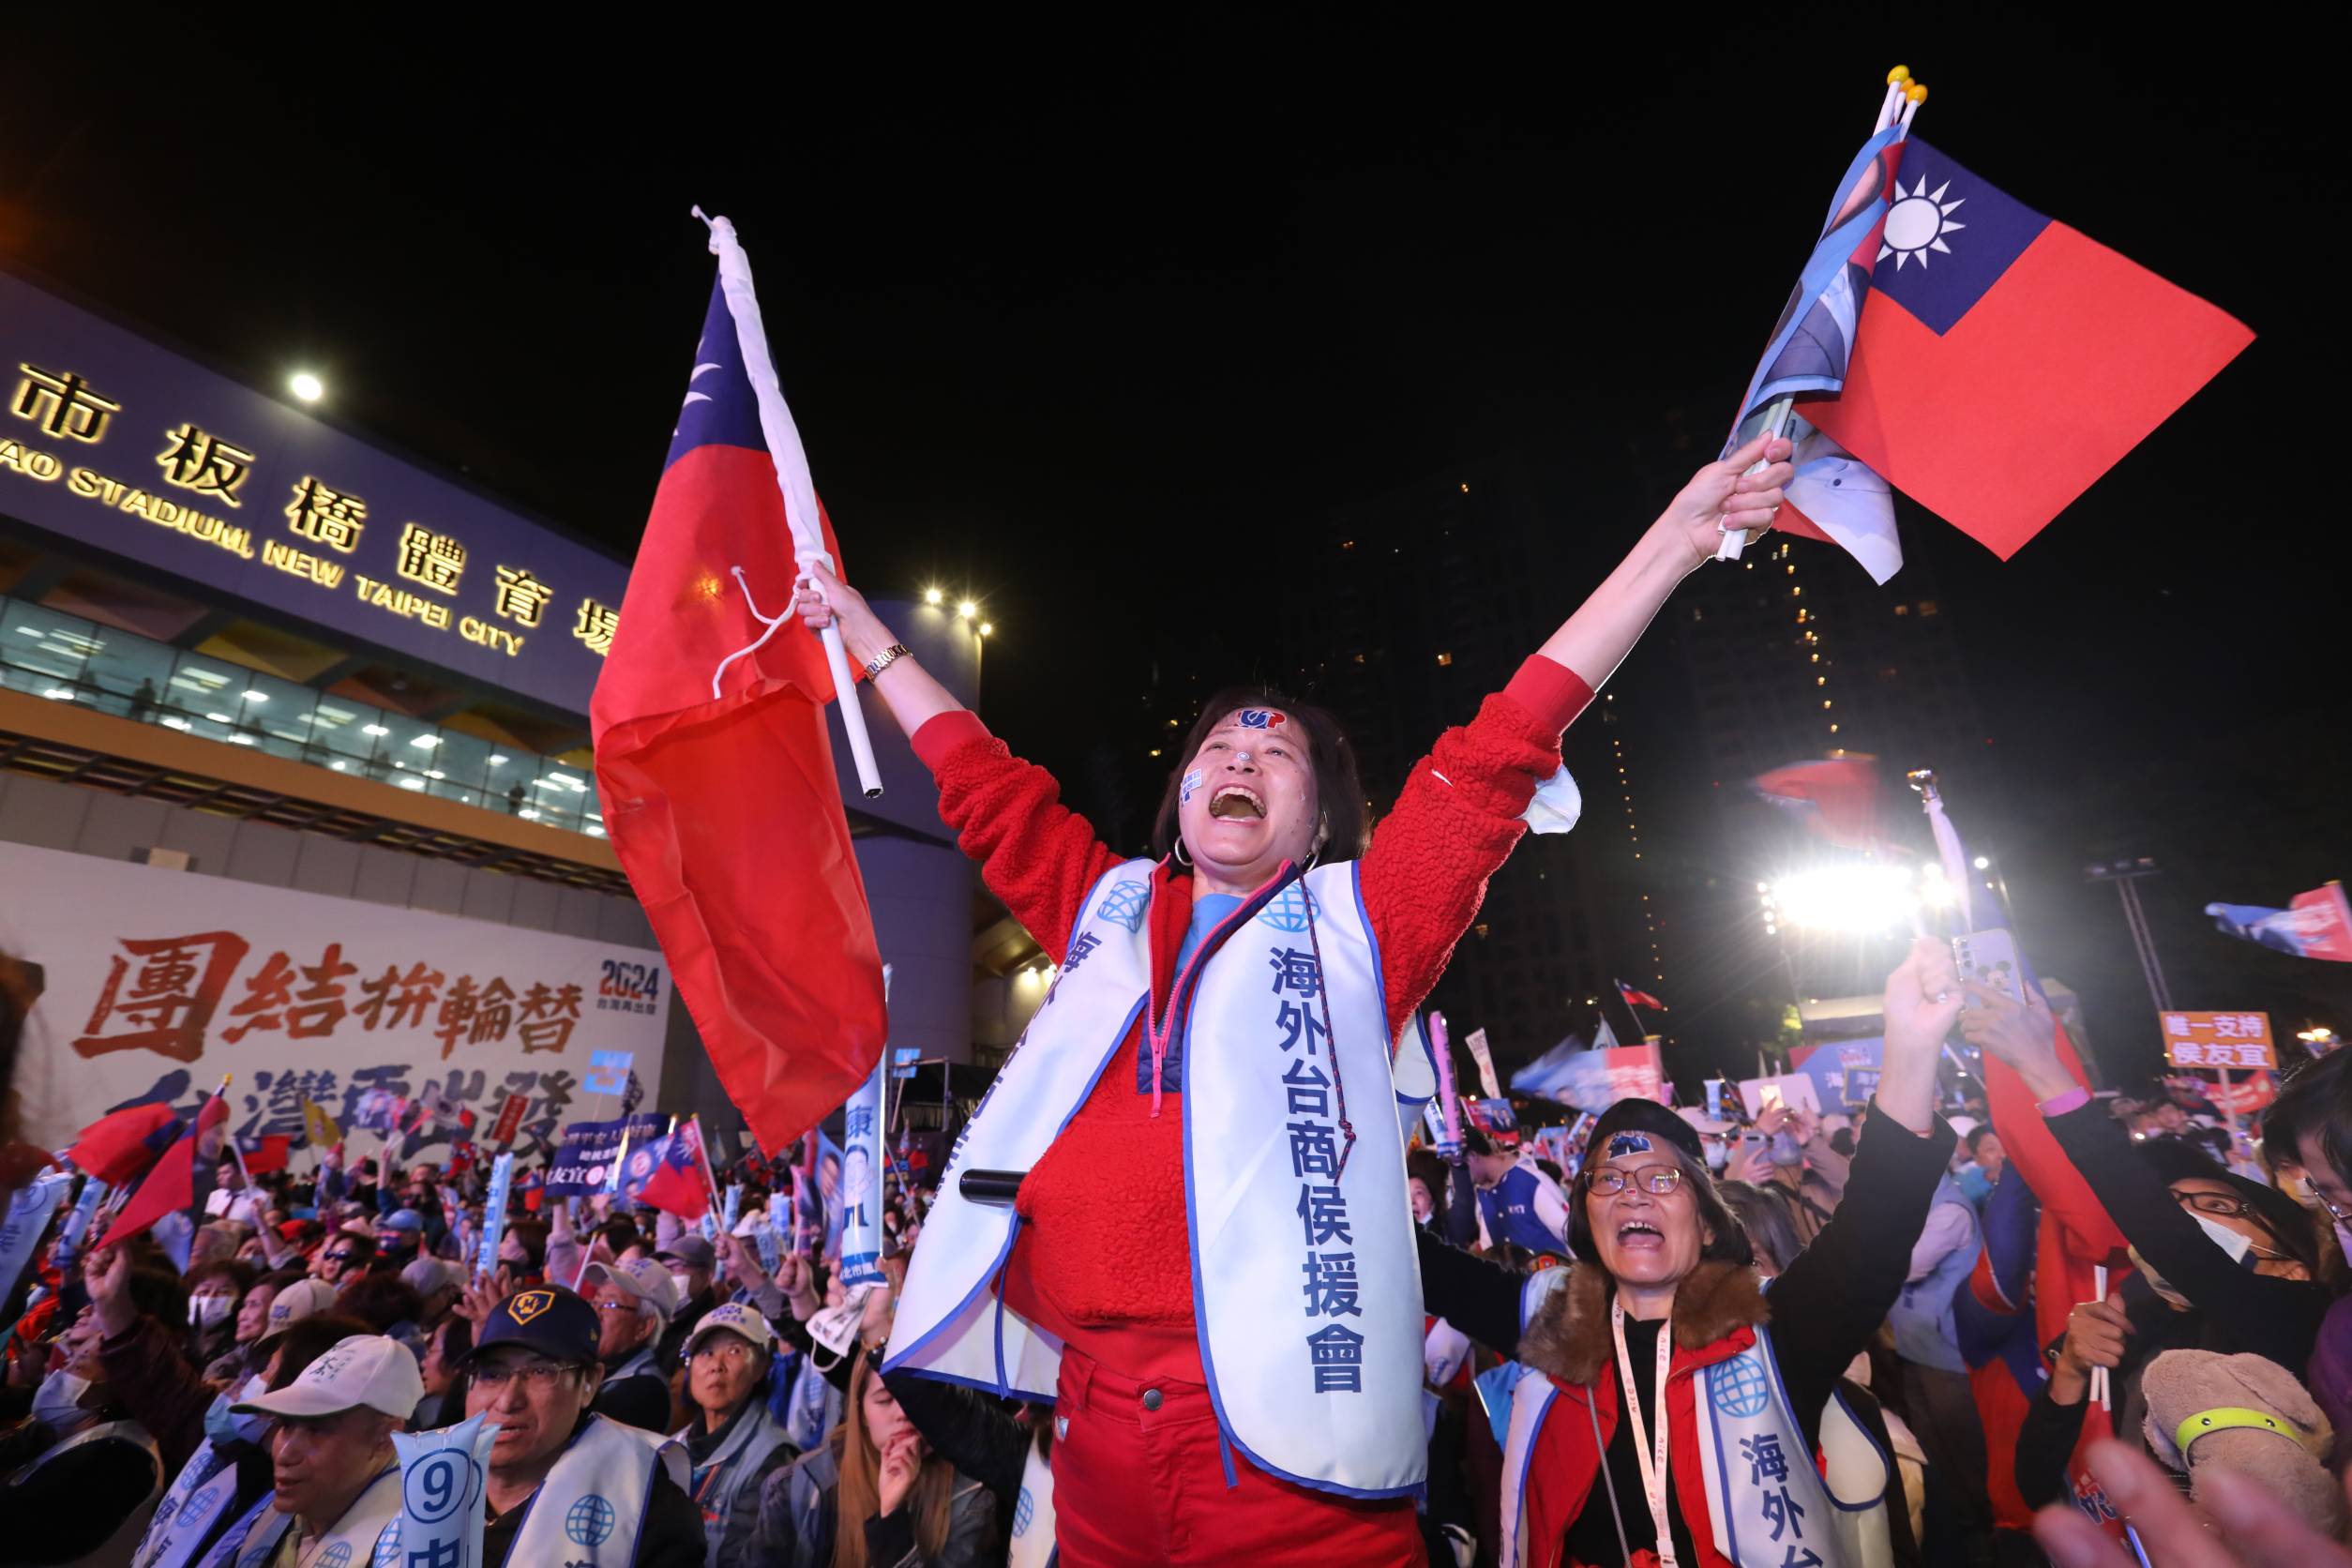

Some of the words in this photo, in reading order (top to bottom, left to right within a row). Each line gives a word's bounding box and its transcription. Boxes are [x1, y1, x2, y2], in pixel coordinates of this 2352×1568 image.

[68, 467, 254, 559] STADIUM,
[263, 539, 345, 588] NEW
[354, 574, 452, 631] TAIPEI
[460, 615, 525, 656] CITY
[600, 959, 659, 1002] 2024
[2165, 1015, 2264, 1038] 唯一支持
[2172, 1041, 2270, 1066] 侯友宜
[1269, 945, 1365, 1395] 海外台商侯援會
